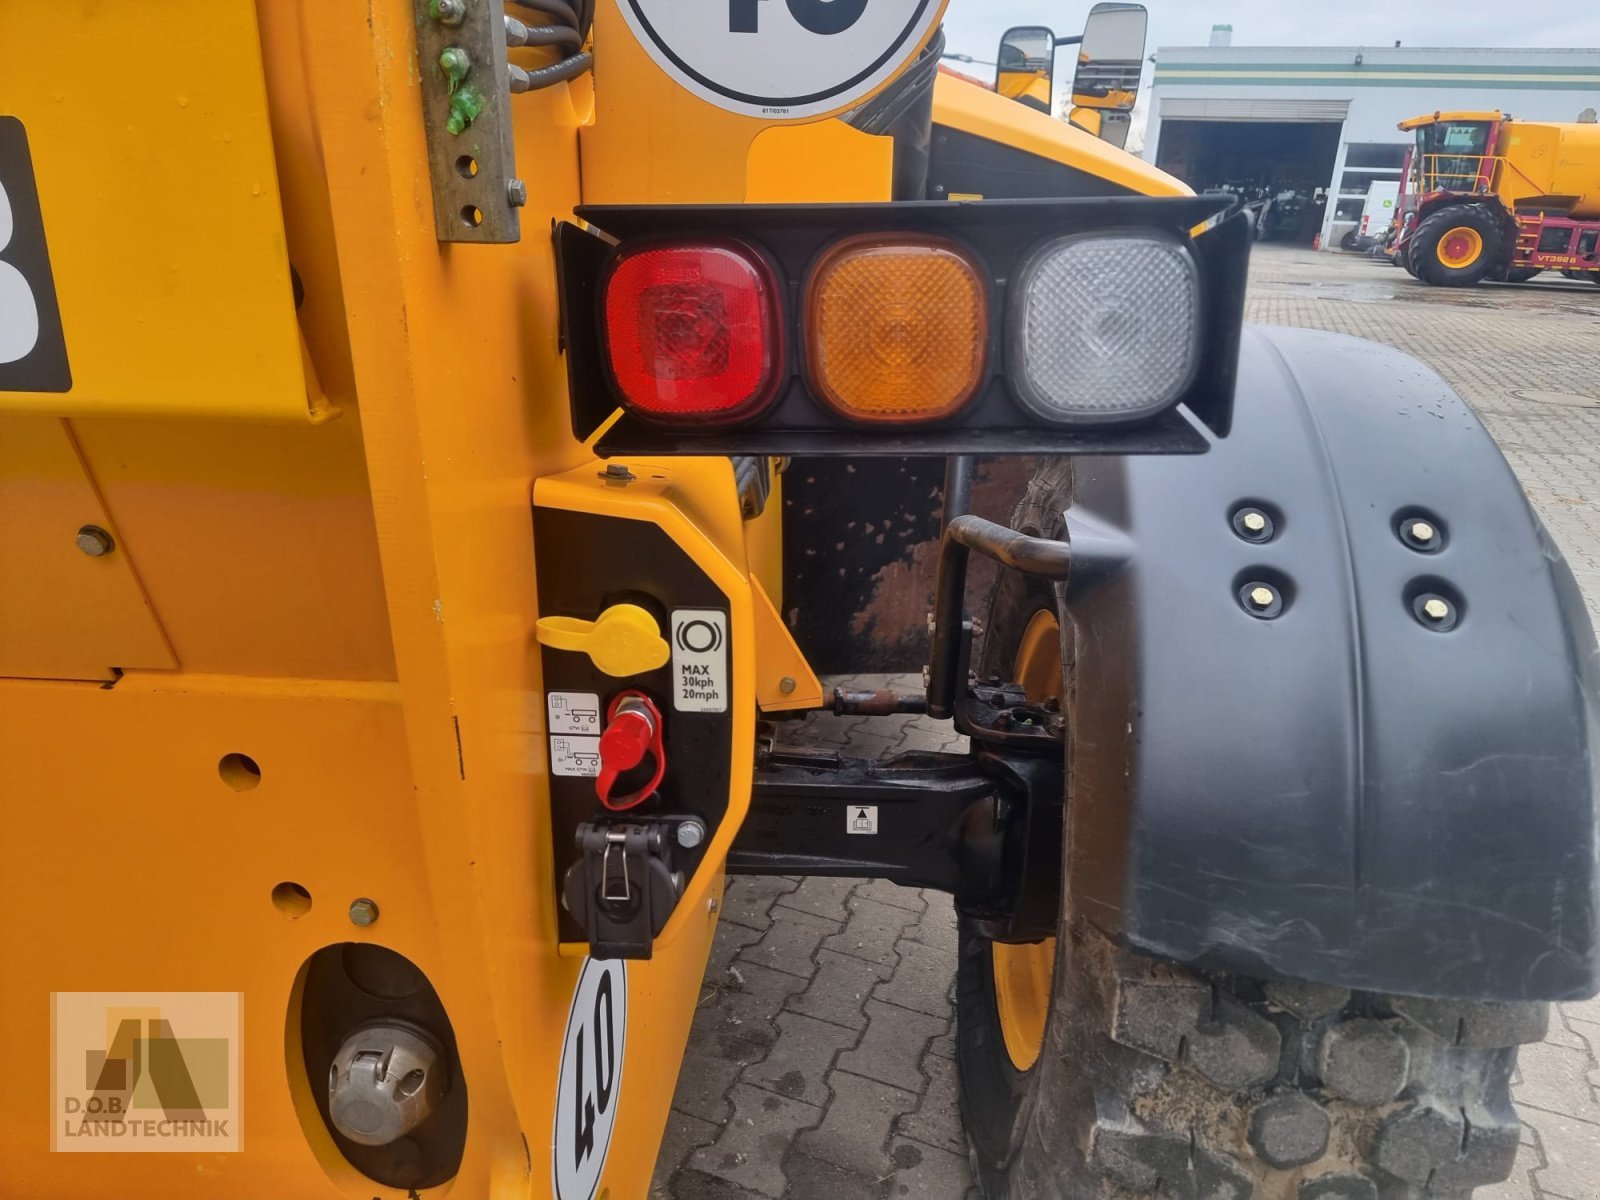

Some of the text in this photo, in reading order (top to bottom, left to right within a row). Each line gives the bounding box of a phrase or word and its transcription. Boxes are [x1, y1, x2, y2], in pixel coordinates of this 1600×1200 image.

[682, 665, 709, 675] MAX
[682, 676, 714, 689] 30kph
[683, 689, 719, 702] 20mph
[575, 969, 614, 1173] 40
